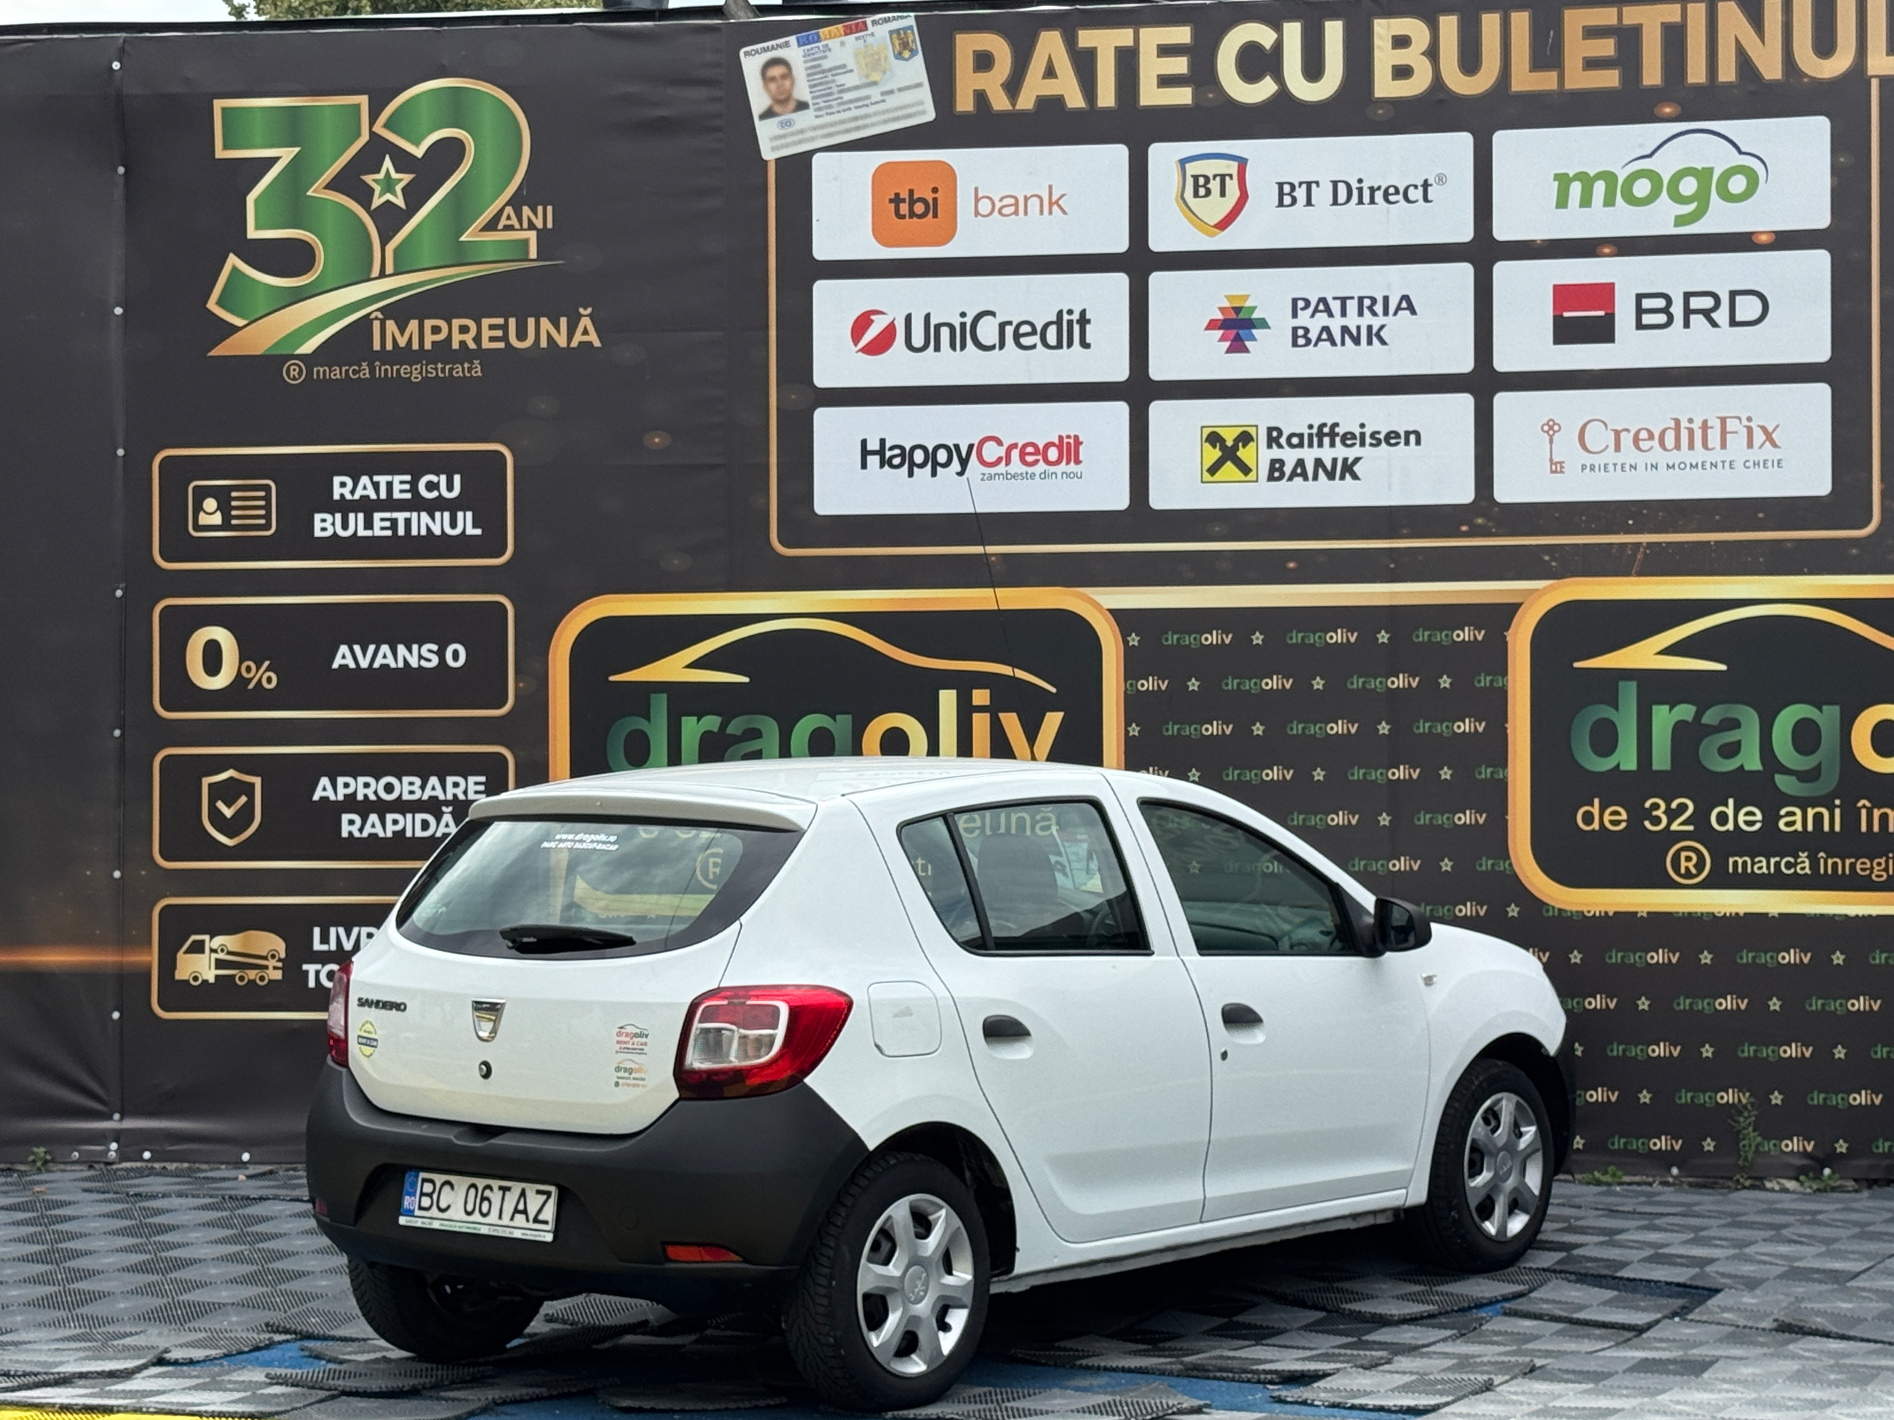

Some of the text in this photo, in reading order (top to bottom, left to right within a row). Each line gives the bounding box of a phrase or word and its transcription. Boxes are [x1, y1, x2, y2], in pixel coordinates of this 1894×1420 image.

[743, 40, 792, 58] ROUMANIE
[954, 25, 1193, 113] RATE
[1216, 19, 1343, 104] CU
[1190, 173, 1233, 199] BT
[1275, 180, 1319, 209] BT
[1553, 164, 1760, 228] mogo
[205, 77, 538, 327] 32
[888, 184, 1069, 220] tbi bank
[498, 205, 554, 230] ANI
[1291, 294, 1418, 319] PATRIA
[1634, 288, 1770, 331] BRD
[370, 307, 602, 351] ÎMPREUNĂ
[904, 307, 1092, 353] UniCredit
[1291, 323, 1389, 349] BANK
[312, 361, 371, 380] marcă
[374, 358, 483, 382] înregistrată
[1266, 422, 1422, 450] Raiffeisen
[1577, 415, 1782, 456] CreditFix
[860, 433, 1083, 479] HappyCredit
[1580, 458, 1784, 475] PRIETEN IN MOMENTE CHEIE
[980, 469, 1083, 484] zambeste din nou
[1267, 456, 1363, 484] BANK
[332, 474, 462, 501] RATE CU
[313, 511, 482, 538] BULETINUL
[1162, 626, 1485, 647] dragoliv dragoliv dragoliv
[331, 643, 467, 669] AVANS 0
[1221, 675, 1294, 693] dragoliv
[1346, 673, 1420, 692] dragoliv
[1162, 717, 1486, 738] dragoliv dragoliv dragoliv
[1222, 765, 1294, 784] dragoliv
[1347, 765, 1421, 783] dragoliv
[312, 776, 487, 801] APROBARE
[340, 806, 458, 838] RAPIDĂ
[1287, 809, 1487, 829] dragoliv dragoliv
[1575, 798, 1628, 832] de
[1643, 797, 1695, 831] 32
[1709, 798, 1763, 831] de
[1777, 799, 1841, 832] ani
[1347, 856, 1421, 875] dragoliv
[1727, 851, 1812, 875] marcă
[1605, 948, 1680, 966] dragoliv
[1736, 948, 1812, 966] dragoliv
[357, 997, 407, 1012] SANDERO
[1673, 995, 1748, 1012] dragoliv
[1806, 995, 1882, 1013] dragoliv
[1606, 1042, 1681, 1059] dragoliv
[1738, 1042, 1813, 1060] dragoliv
[1675, 1088, 1750, 1106] dragoliv
[1807, 1089, 1884, 1108] dragoliv
[1608, 1134, 1683, 1152] dragoliv
[404, 1196, 416, 1210] RO
[417, 1177, 455, 1214] BC
